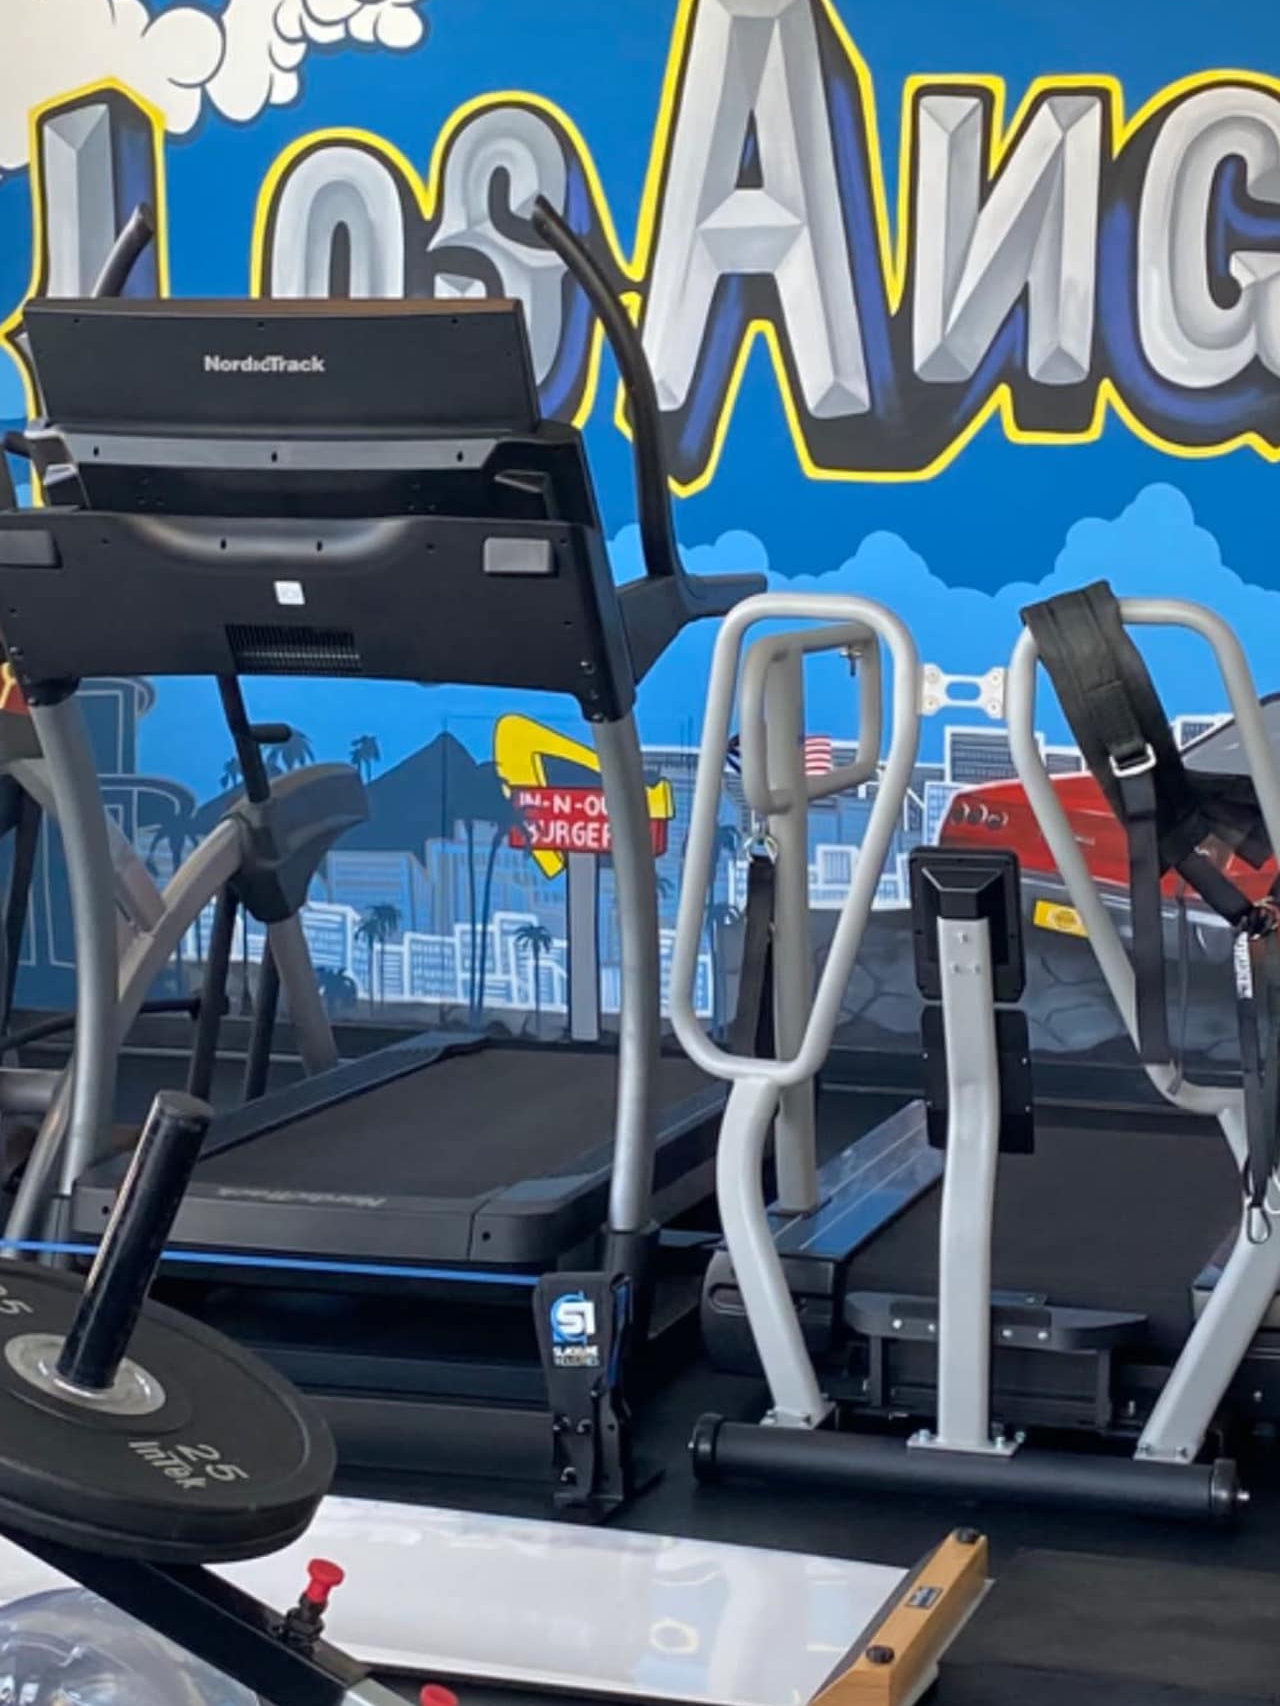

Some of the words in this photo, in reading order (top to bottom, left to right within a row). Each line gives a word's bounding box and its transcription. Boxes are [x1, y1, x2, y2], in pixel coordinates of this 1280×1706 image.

[203, 354, 326, 375] NordicTrack
[519, 791, 610, 817] IN-N-O
[128, 1439, 207, 1491] InTek
[176, 1443, 249, 1483] 25
